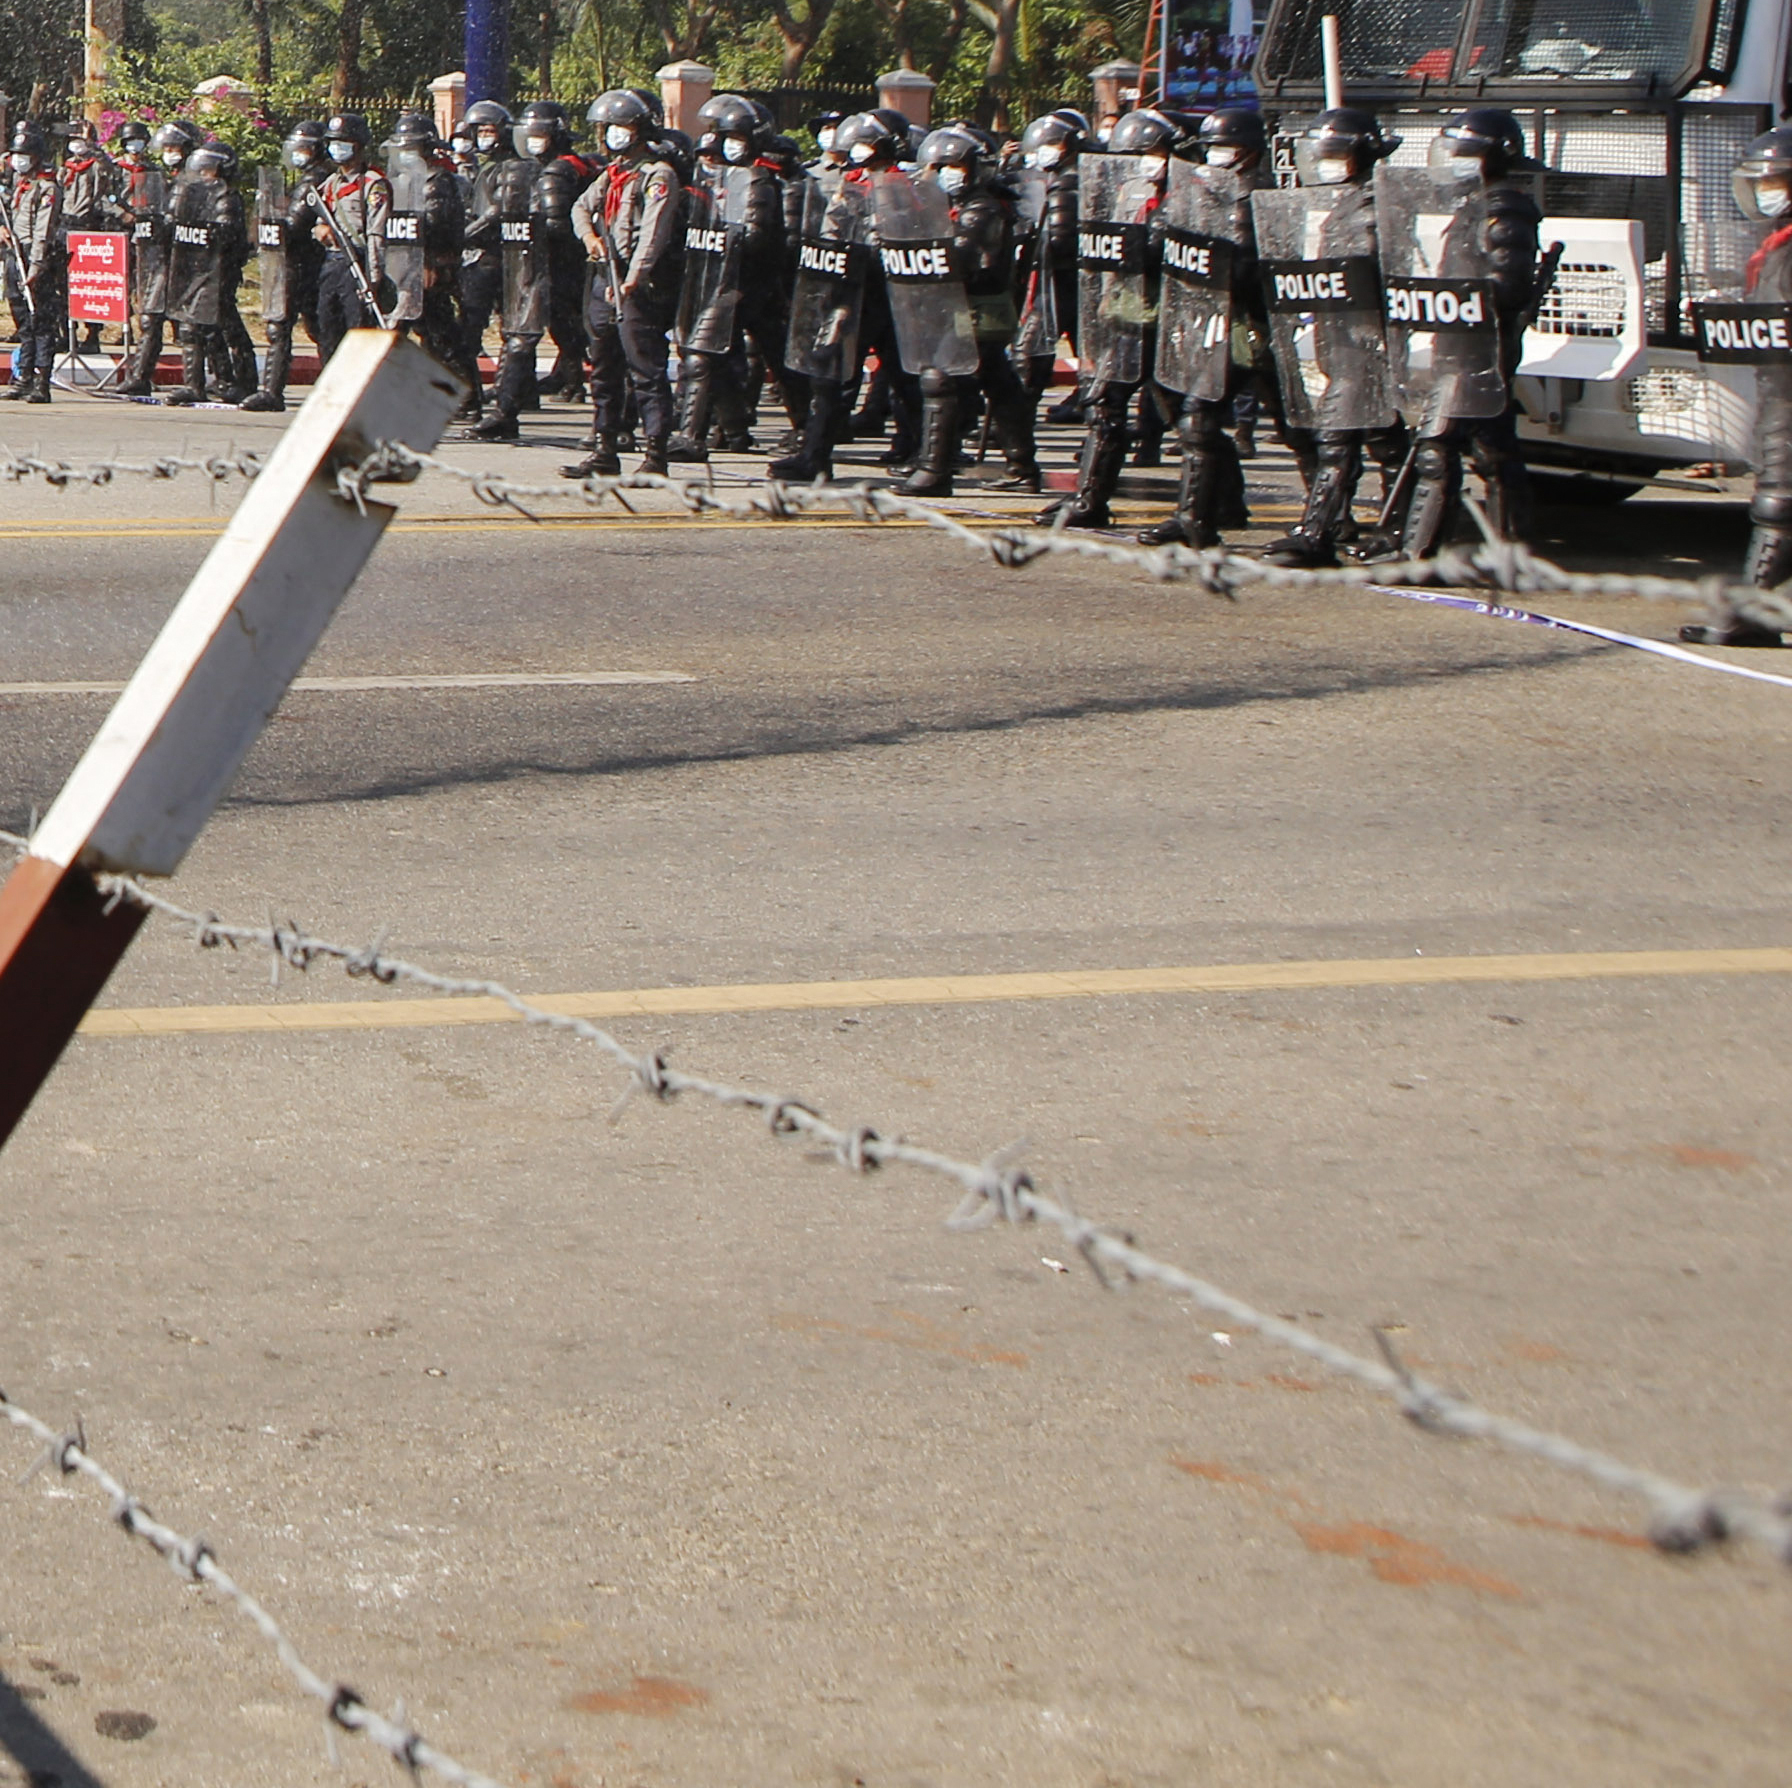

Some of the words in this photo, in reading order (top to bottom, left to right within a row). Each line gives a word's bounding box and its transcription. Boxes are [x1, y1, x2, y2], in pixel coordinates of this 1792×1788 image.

[174, 224, 209, 246] POLICE
[386, 217, 418, 240] LICE
[685, 227, 726, 253] POLICE
[798, 245, 848, 275] POLICE
[879, 246, 951, 276] POLICE
[1078, 232, 1123, 261] POLICE
[1163, 237, 1211, 275] POLICE
[1274, 271, 1347, 300] POLICE
[1386, 286, 1485, 325] POLICE
[1703, 318, 1790, 350] POLICE
